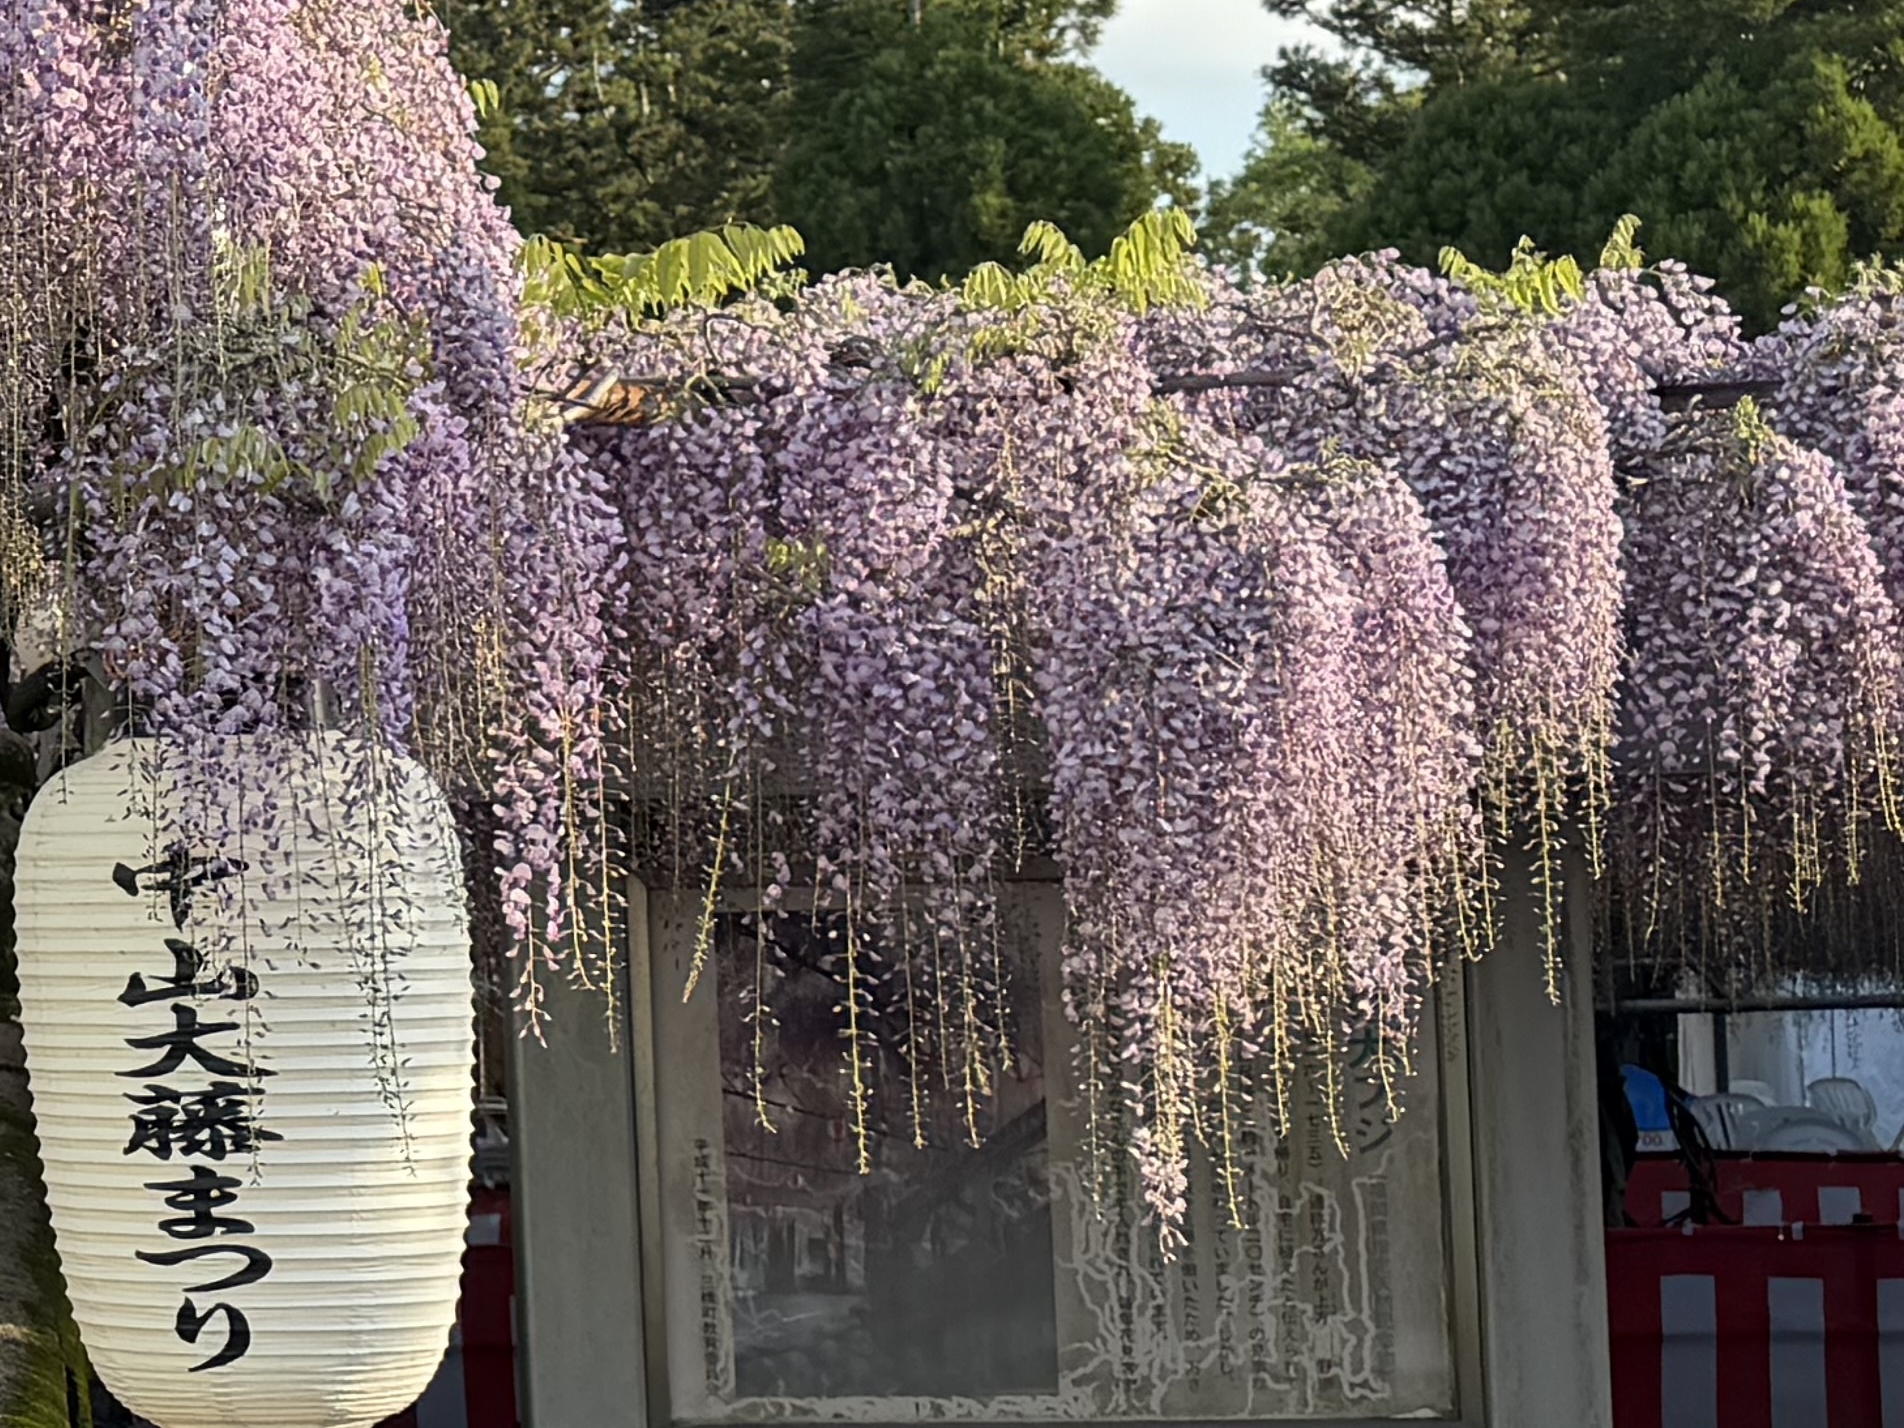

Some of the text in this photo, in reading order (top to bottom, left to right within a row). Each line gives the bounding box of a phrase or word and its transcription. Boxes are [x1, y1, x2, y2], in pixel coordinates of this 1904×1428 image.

[113, 840, 283, 1373] 中山大藤まつり
